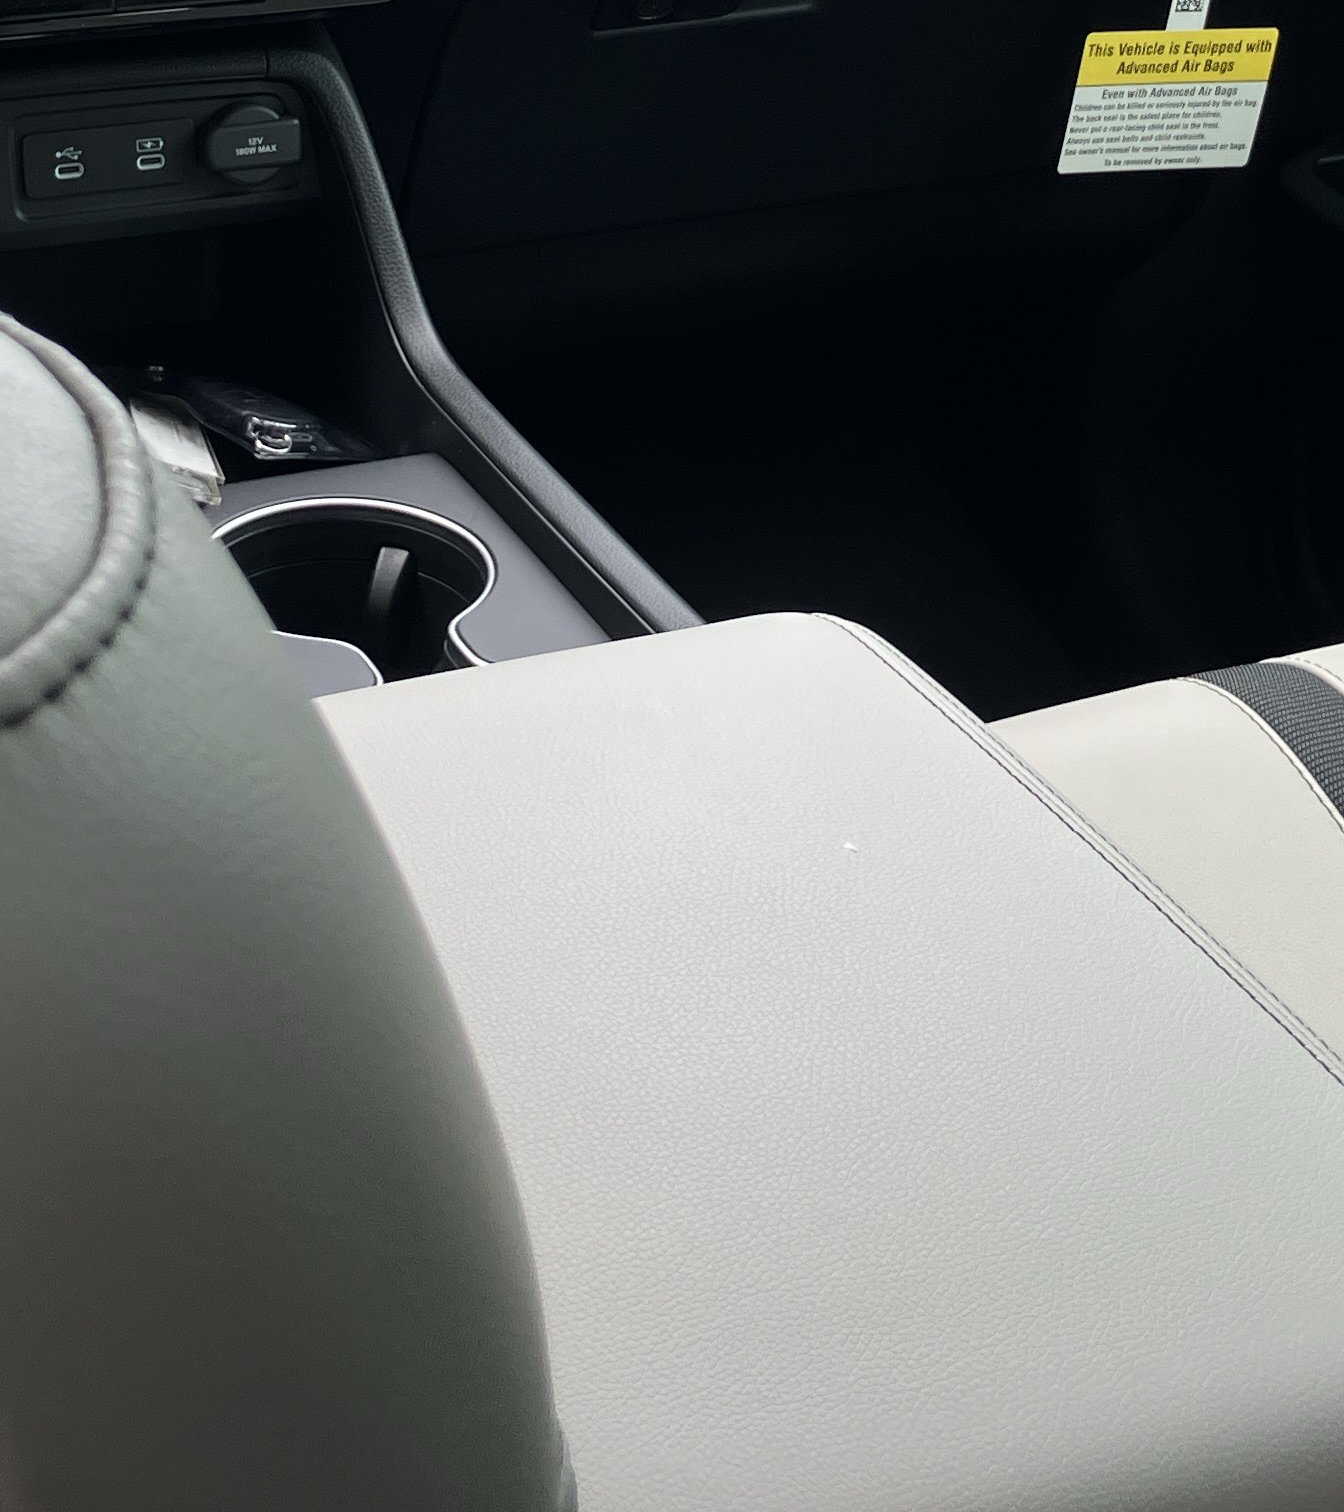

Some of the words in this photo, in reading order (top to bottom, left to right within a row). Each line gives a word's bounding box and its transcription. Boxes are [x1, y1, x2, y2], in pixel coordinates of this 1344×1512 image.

[1088, 44, 1113, 57] This
[1119, 42, 1165, 56] Vehicle
[1169, 42, 1179, 55] is
[1184, 40, 1242, 56] Equipped
[1247, 39, 1272, 53] with
[1116, 60, 1178, 75] Advanced
[1181, 60, 1199, 73] Air
[1203, 59, 1235, 75] Bags
[1102, 90, 1125, 100] Even
[1127, 89, 1147, 98] with
[1149, 87, 1196, 98] Advanced
[1198, 87, 1212, 96] Air
[1214, 86, 1238, 98] Bags
[248, 136, 264, 146] 12V
[258, 144, 277, 153] MAX
